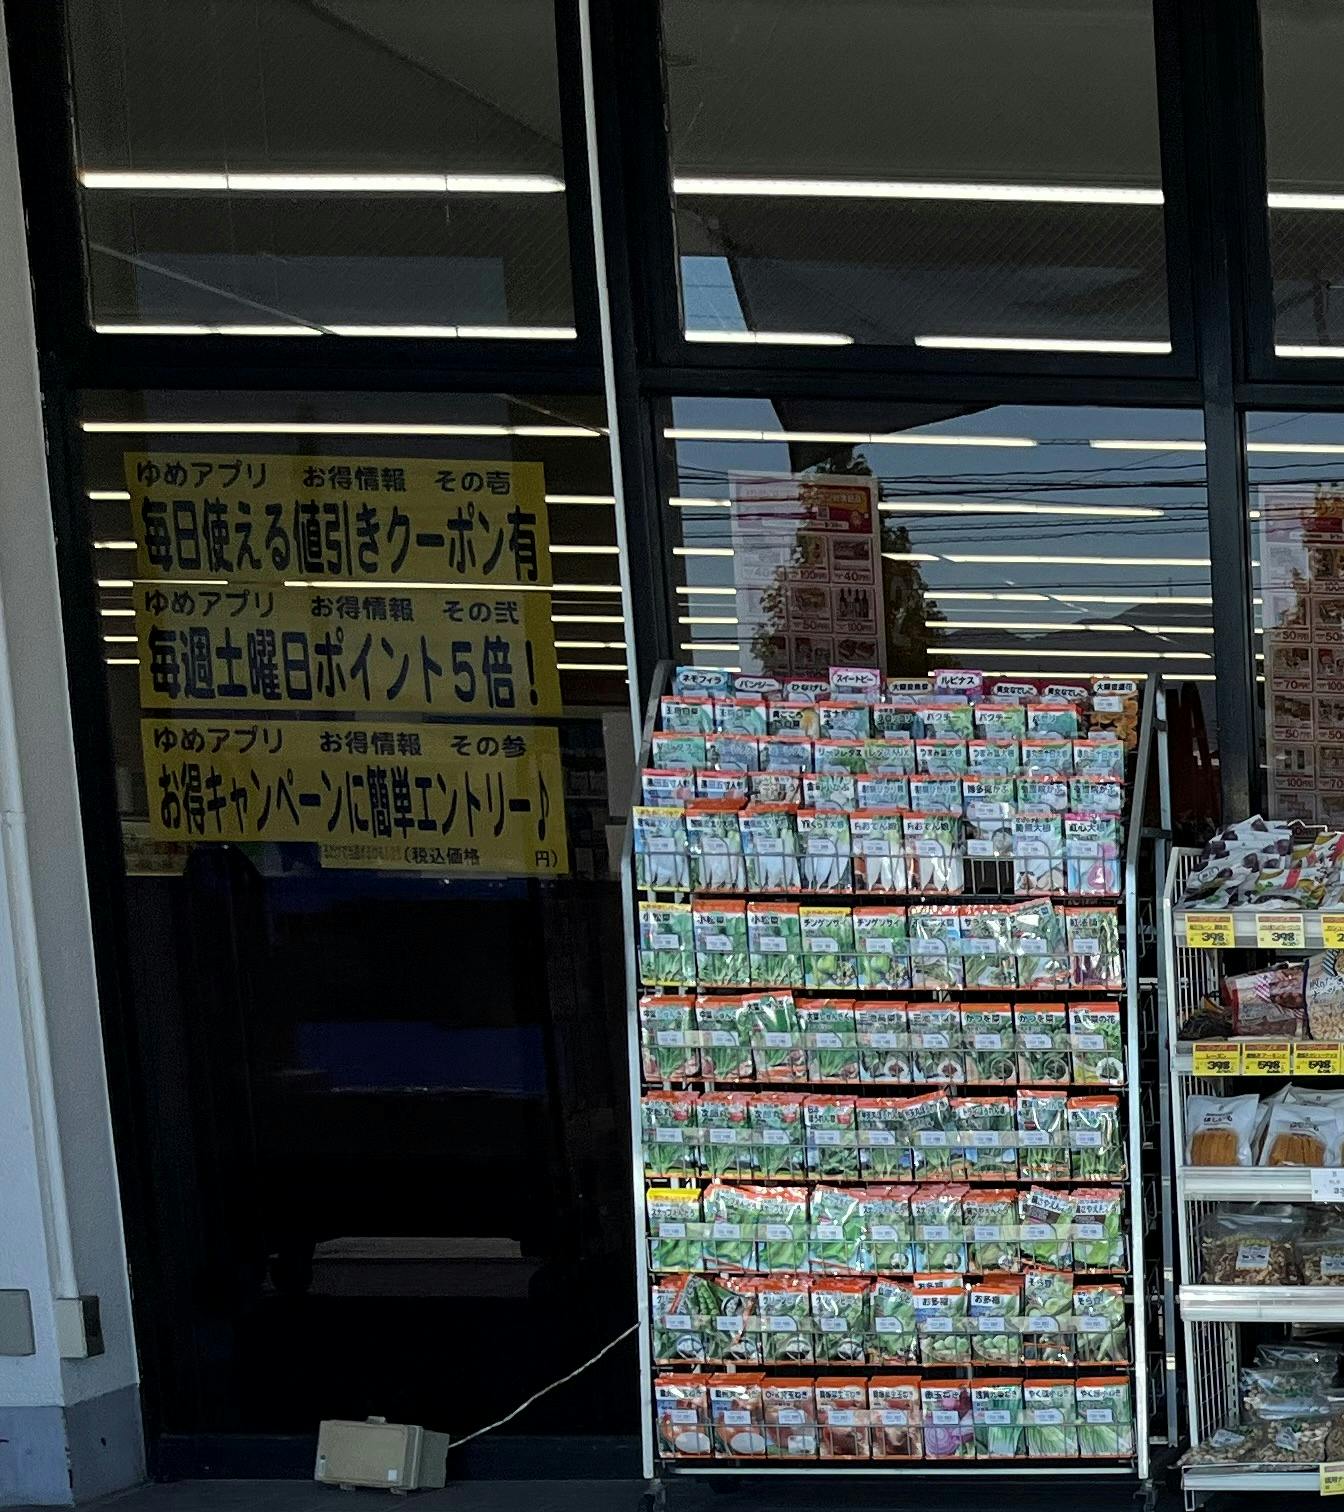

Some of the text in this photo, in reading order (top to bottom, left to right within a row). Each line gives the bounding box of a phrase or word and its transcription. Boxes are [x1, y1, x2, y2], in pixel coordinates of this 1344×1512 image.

[137, 462, 511, 493] ゆめアプリ お得情報 その壱
[141, 496, 538, 581] 毎日使える値引きクーポン有
[145, 591, 274, 618] ゆめアプリ
[311, 597, 415, 622] お得情報
[682, 675, 722, 685] ネモフィラ
[153, 726, 527, 758] ゆめアプリ お得情報 その参
[1202, 932, 1225, 942] 398
[1271, 932, 1296, 942] 398
